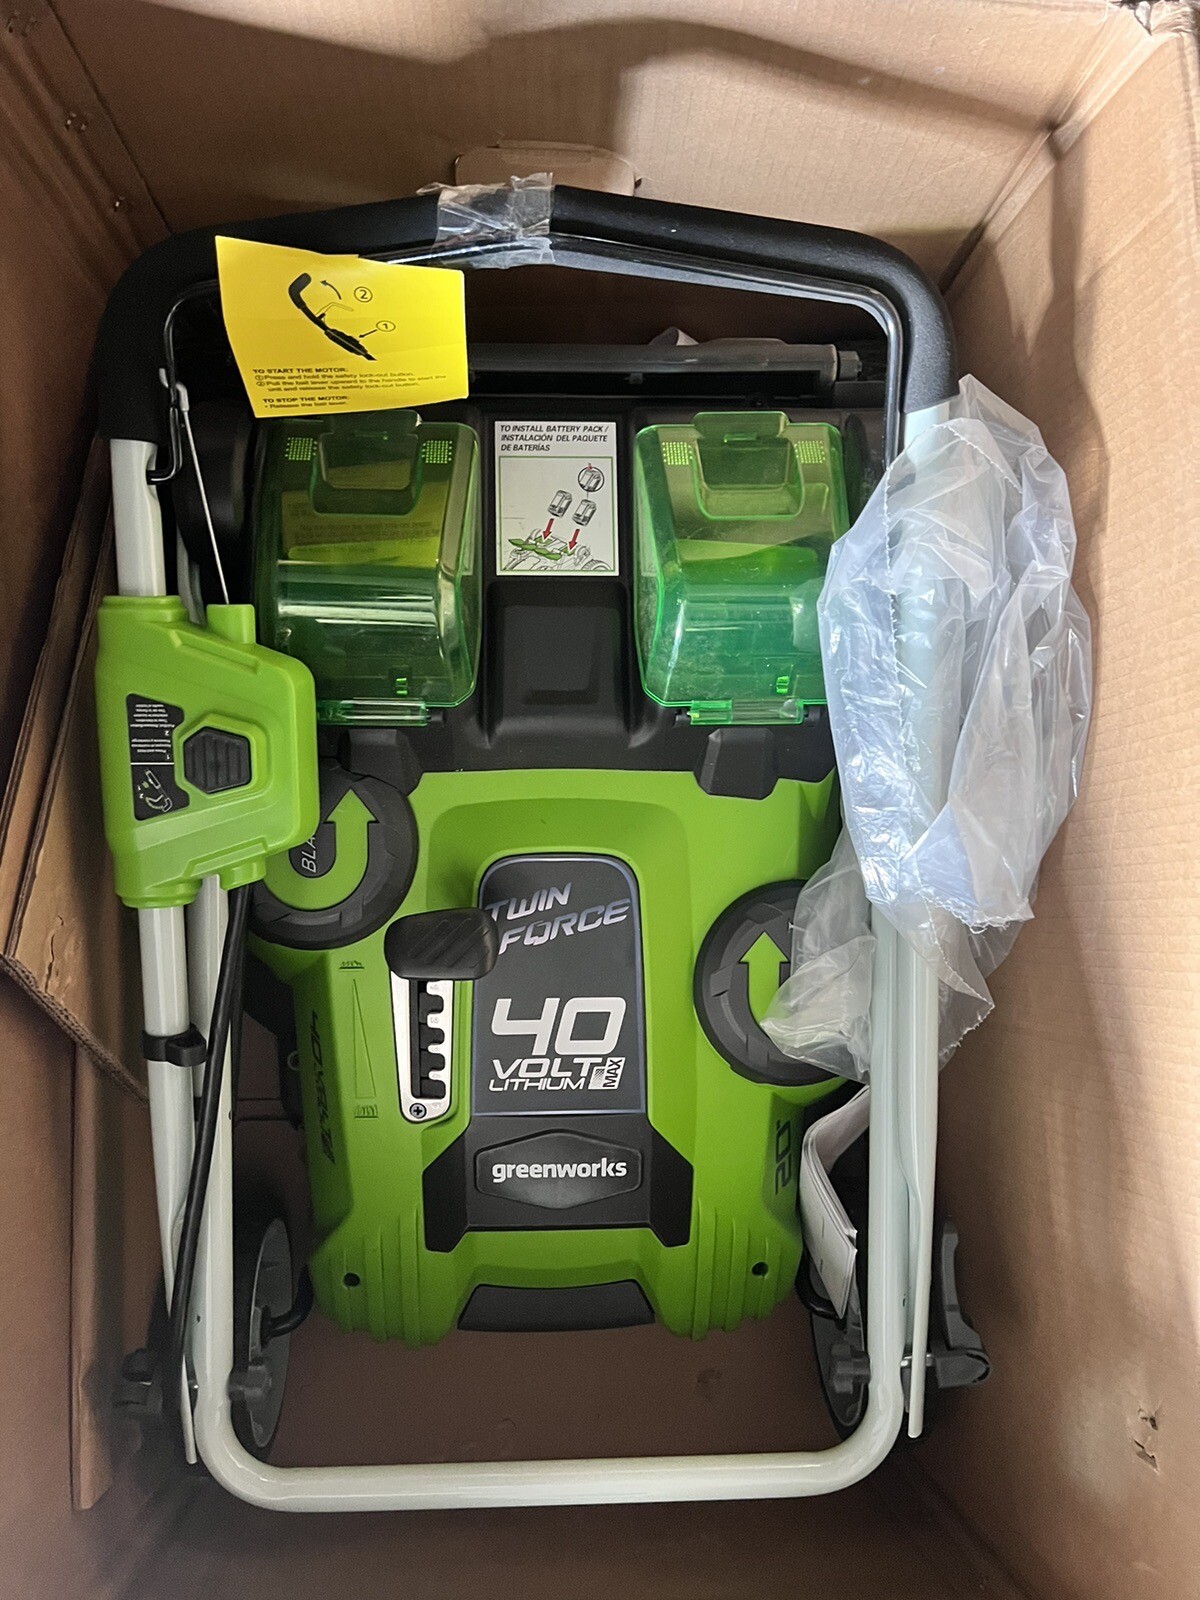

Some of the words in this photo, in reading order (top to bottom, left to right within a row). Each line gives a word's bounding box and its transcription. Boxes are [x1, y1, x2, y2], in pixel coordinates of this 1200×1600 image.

[500, 424, 511, 433] TO
[512, 424, 544, 433] INSTALL
[546, 424, 580, 433] BATTERY
[583, 425, 603, 433] PACK
[501, 433, 553, 442] INSTALACIÓN
[556, 434, 570, 442] DEL
[572, 434, 608, 443] PAQUETE
[512, 442, 551, 451] BATERÍAS
[484, 882, 572, 922] TWIN
[498, 898, 632, 955] FORCE
[491, 996, 627, 1056] 40
[488, 1077, 586, 1091] LITHIUM
[492, 1057, 602, 1079] VOLT
[602, 1058, 624, 1088] MAX
[491, 1157, 628, 1183] greenworks
